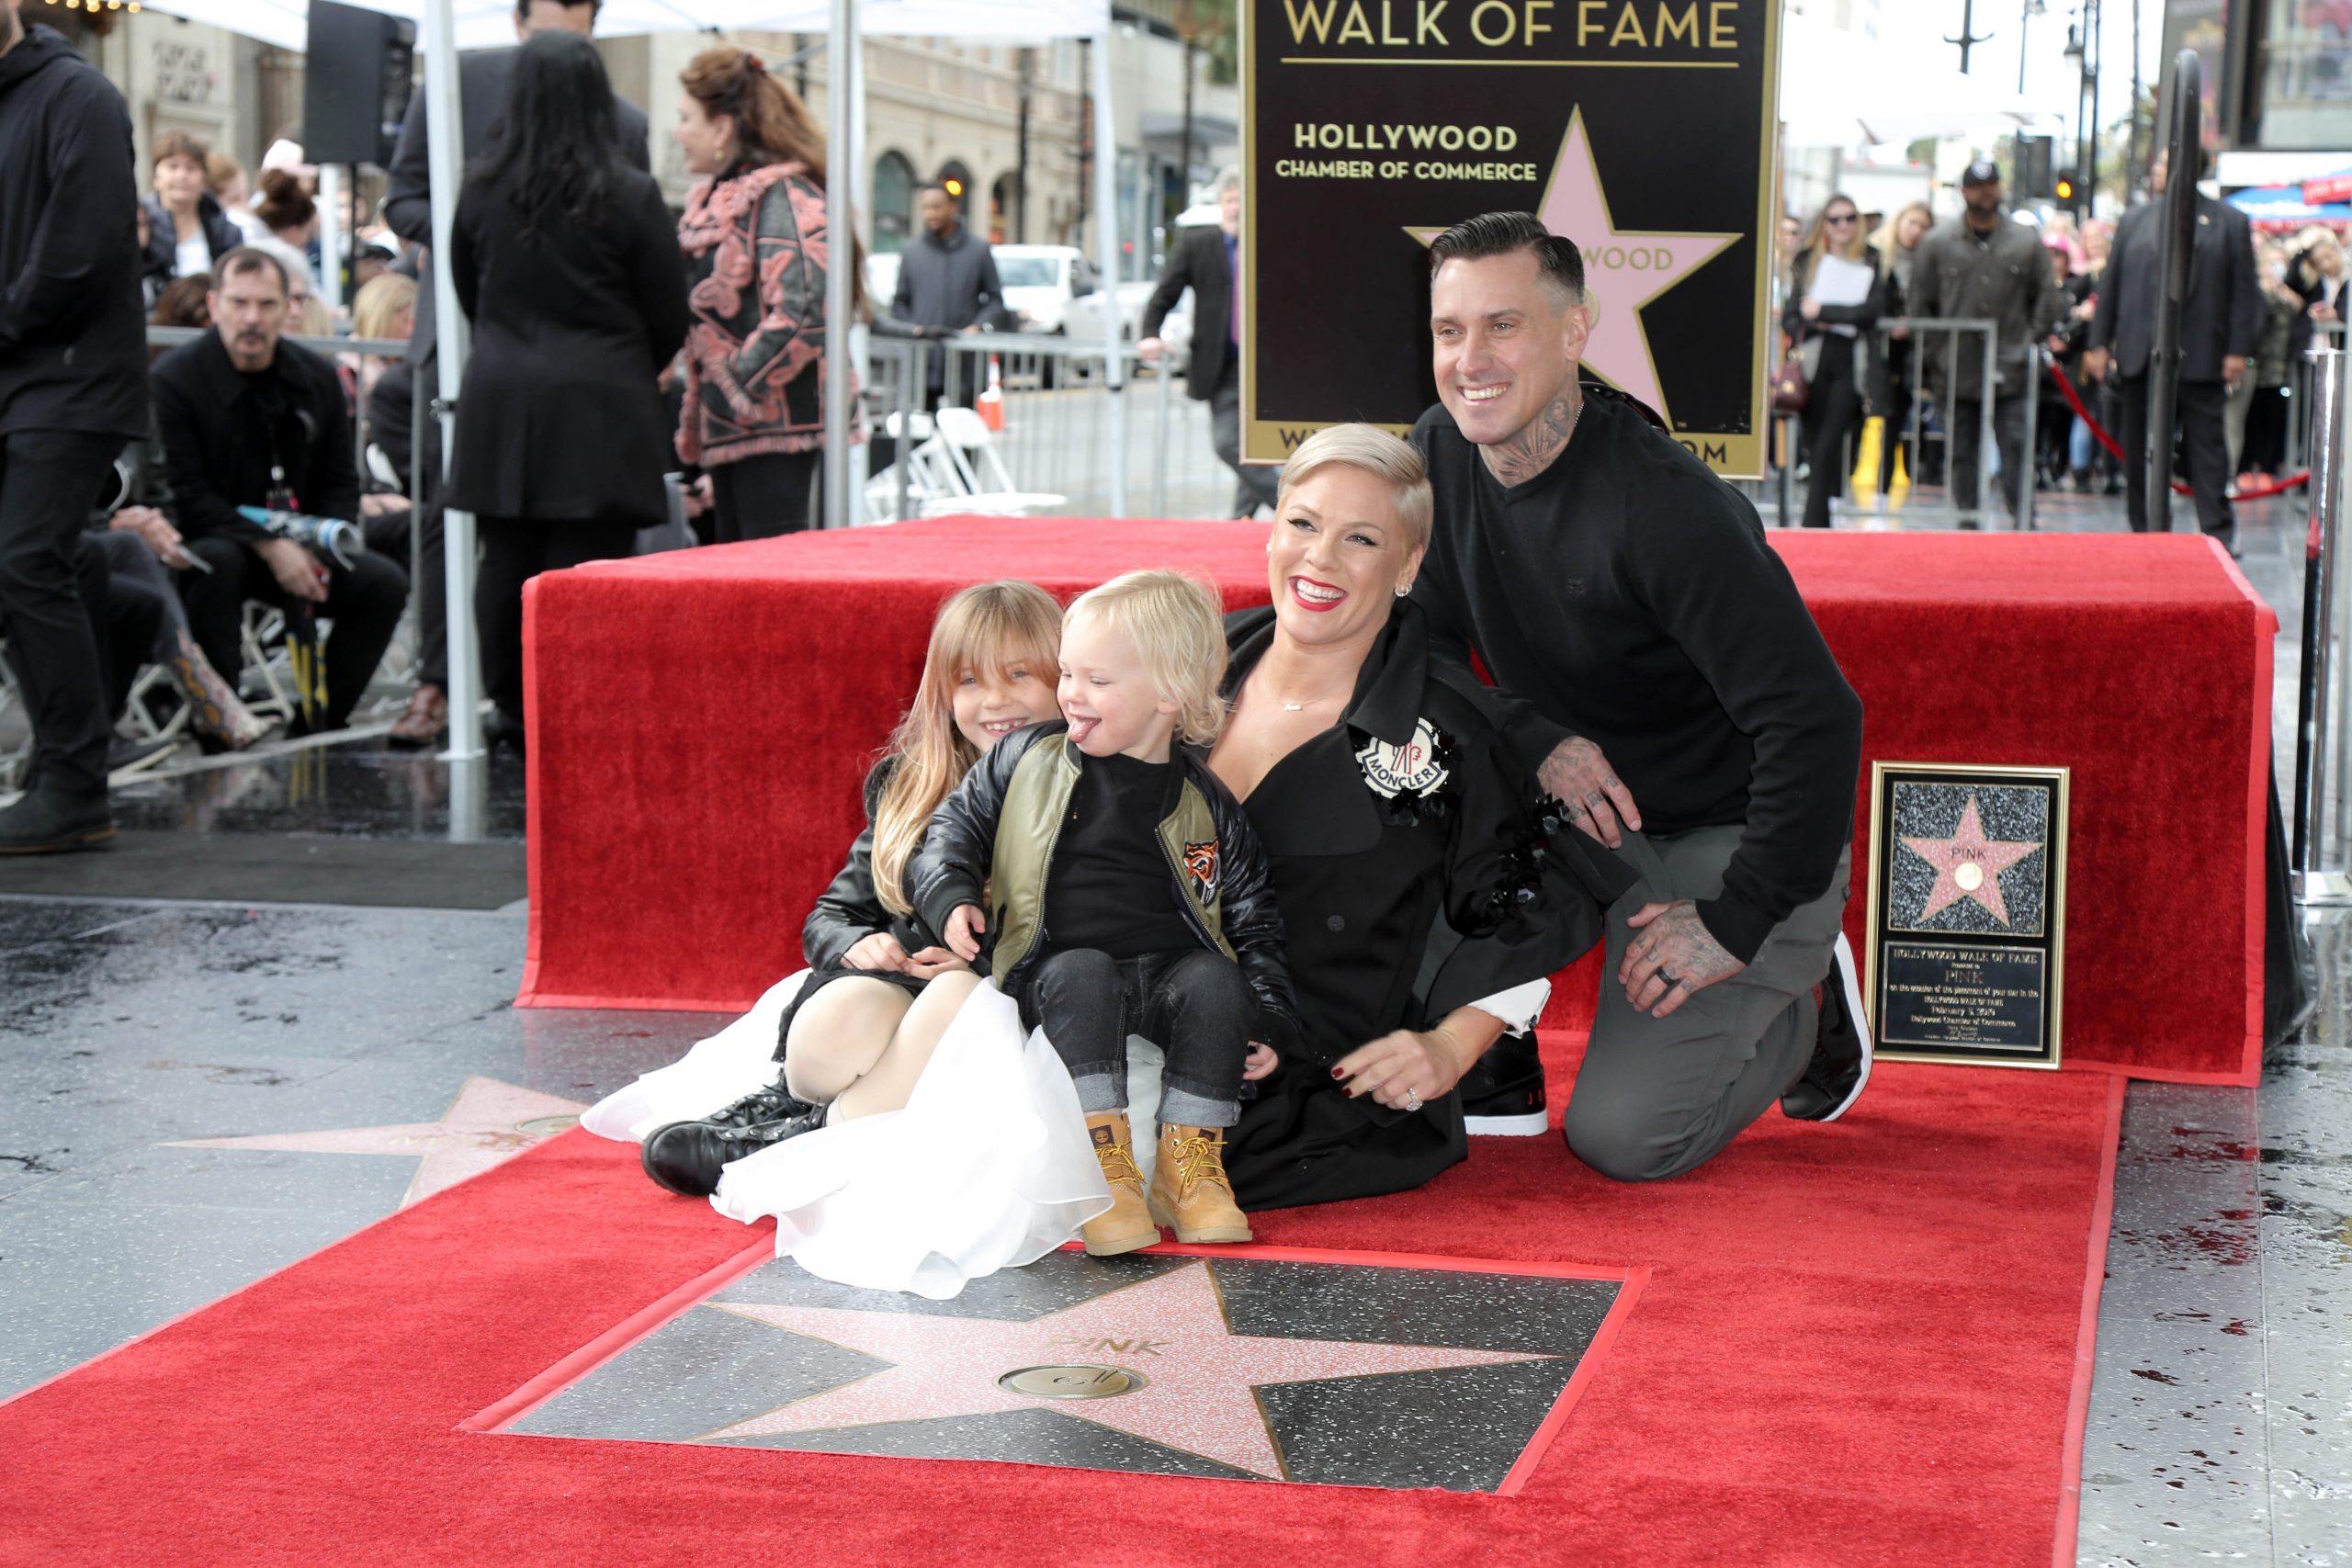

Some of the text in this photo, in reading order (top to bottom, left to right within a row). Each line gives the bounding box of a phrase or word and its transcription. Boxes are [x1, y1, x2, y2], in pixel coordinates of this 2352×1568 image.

[1284, 0, 1740, 49] WALK OF FAME
[1294, 122, 1518, 152] HOLLYWOOD
[1275, 159, 1537, 181] CHAMBER OF COMMERCE
[1368, 758, 1434, 789] MONCLER
[1951, 847, 1986, 860] PINK
[1894, 949, 2037, 964] HOLLYWOOD WALK OF FAME
[1945, 970, 1984, 984] PINK
[1045, 1333, 1174, 1357] PINK
